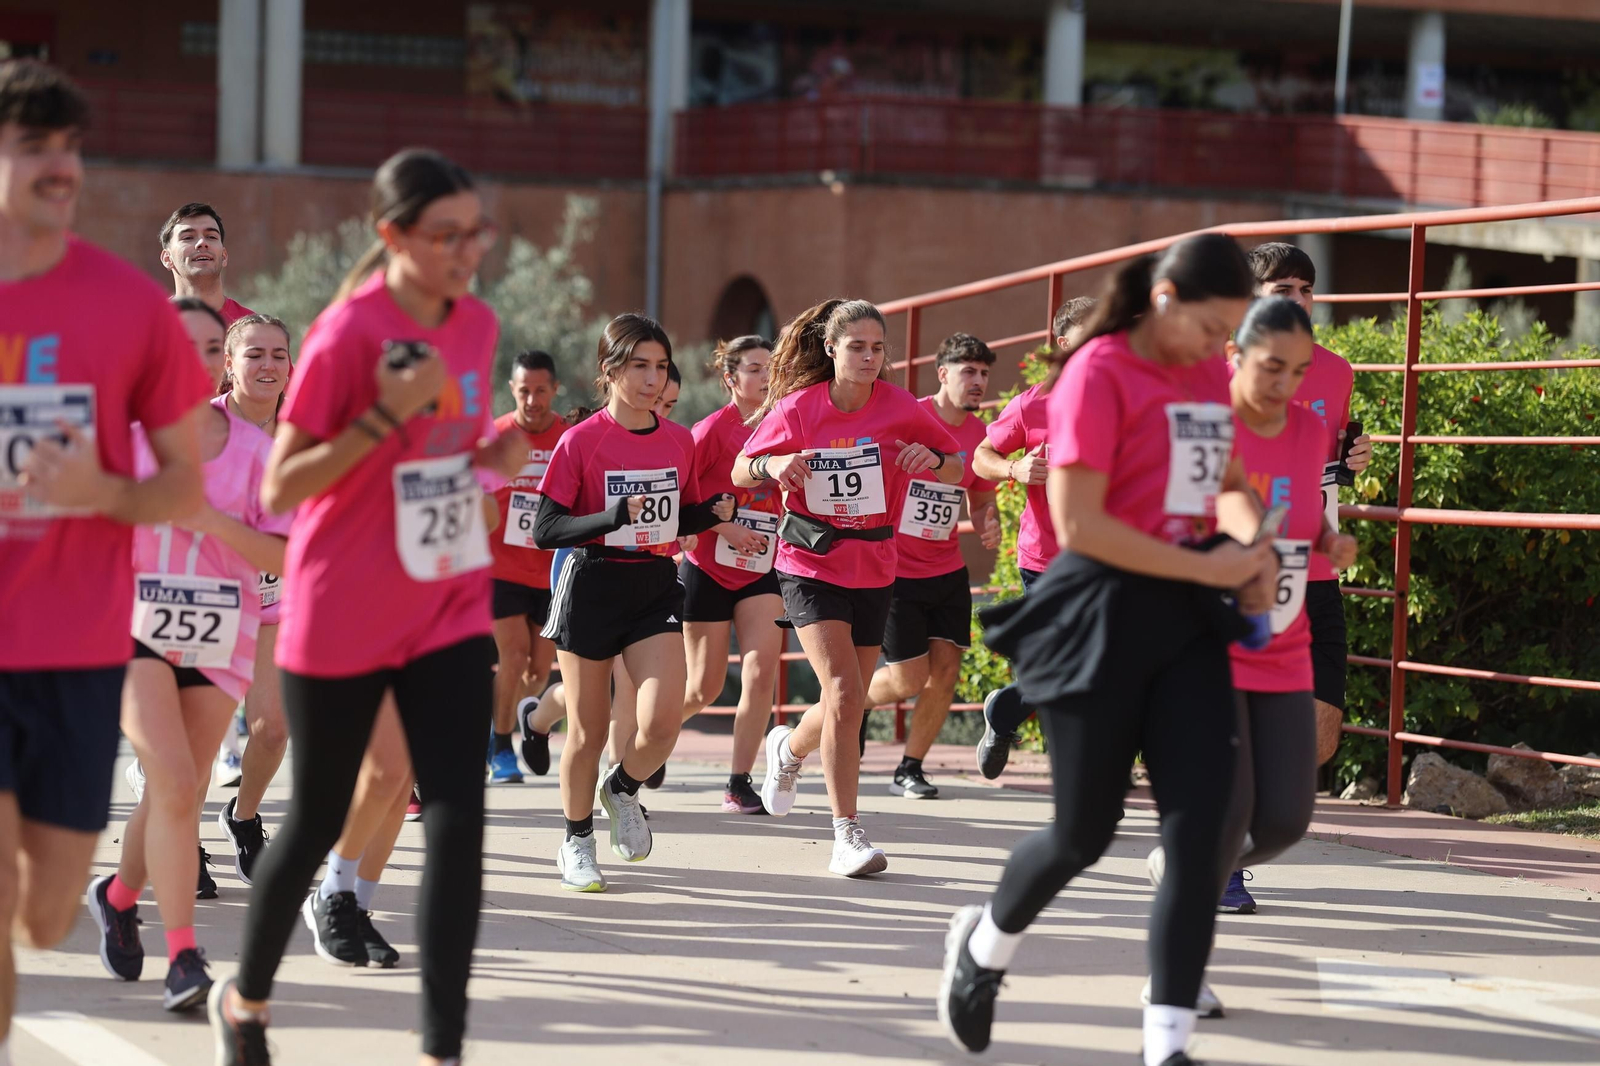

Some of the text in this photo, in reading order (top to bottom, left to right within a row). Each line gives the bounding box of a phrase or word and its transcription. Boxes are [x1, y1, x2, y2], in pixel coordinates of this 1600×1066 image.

[807, 460, 841, 469] UMA
[609, 483, 647, 494] UMA
[828, 472, 862, 497] 19
[911, 488, 939, 500] UMA
[633, 496, 671, 524] 80
[914, 501, 952, 525] 359
[519, 512, 537, 531] 6
[733, 518, 753, 529] MA
[141, 587, 187, 603] UMA
[1275, 574, 1293, 604] 6
[152, 608, 221, 643] 252
